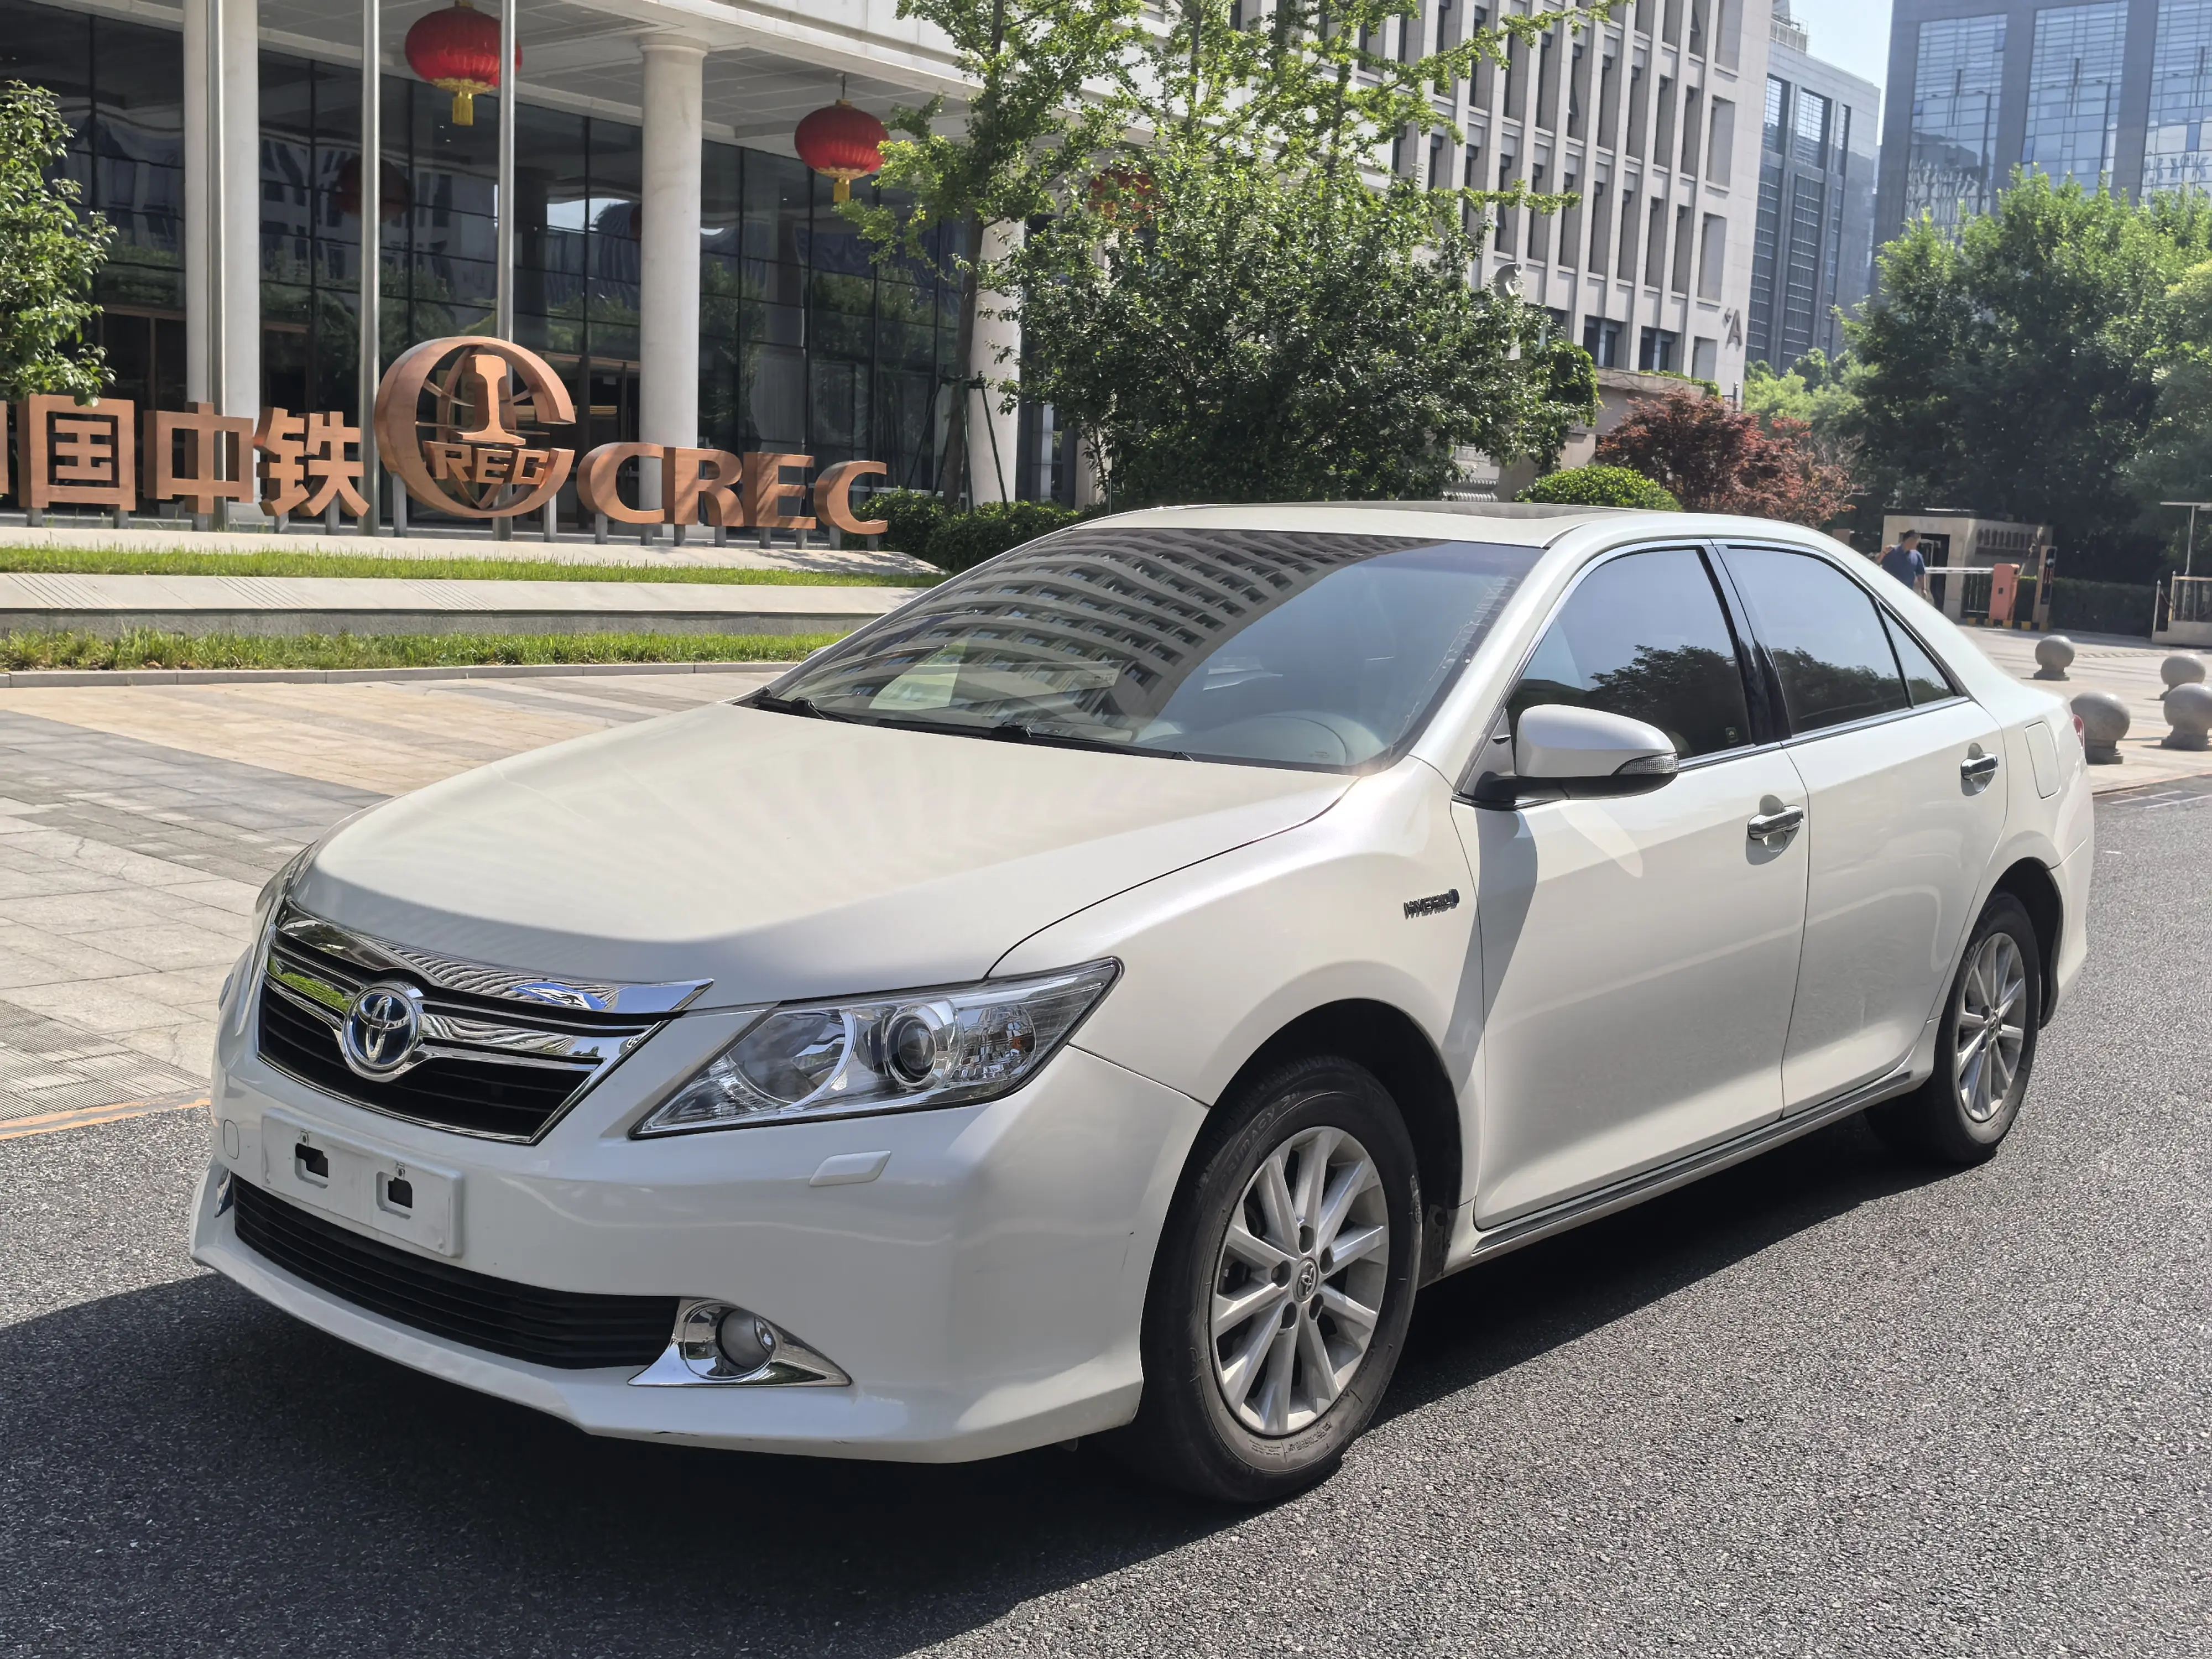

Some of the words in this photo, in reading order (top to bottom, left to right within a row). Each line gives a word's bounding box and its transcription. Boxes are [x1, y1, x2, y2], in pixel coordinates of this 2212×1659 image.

[0, 394, 369, 517] 国中铁
[577, 442, 888, 535] CREC
